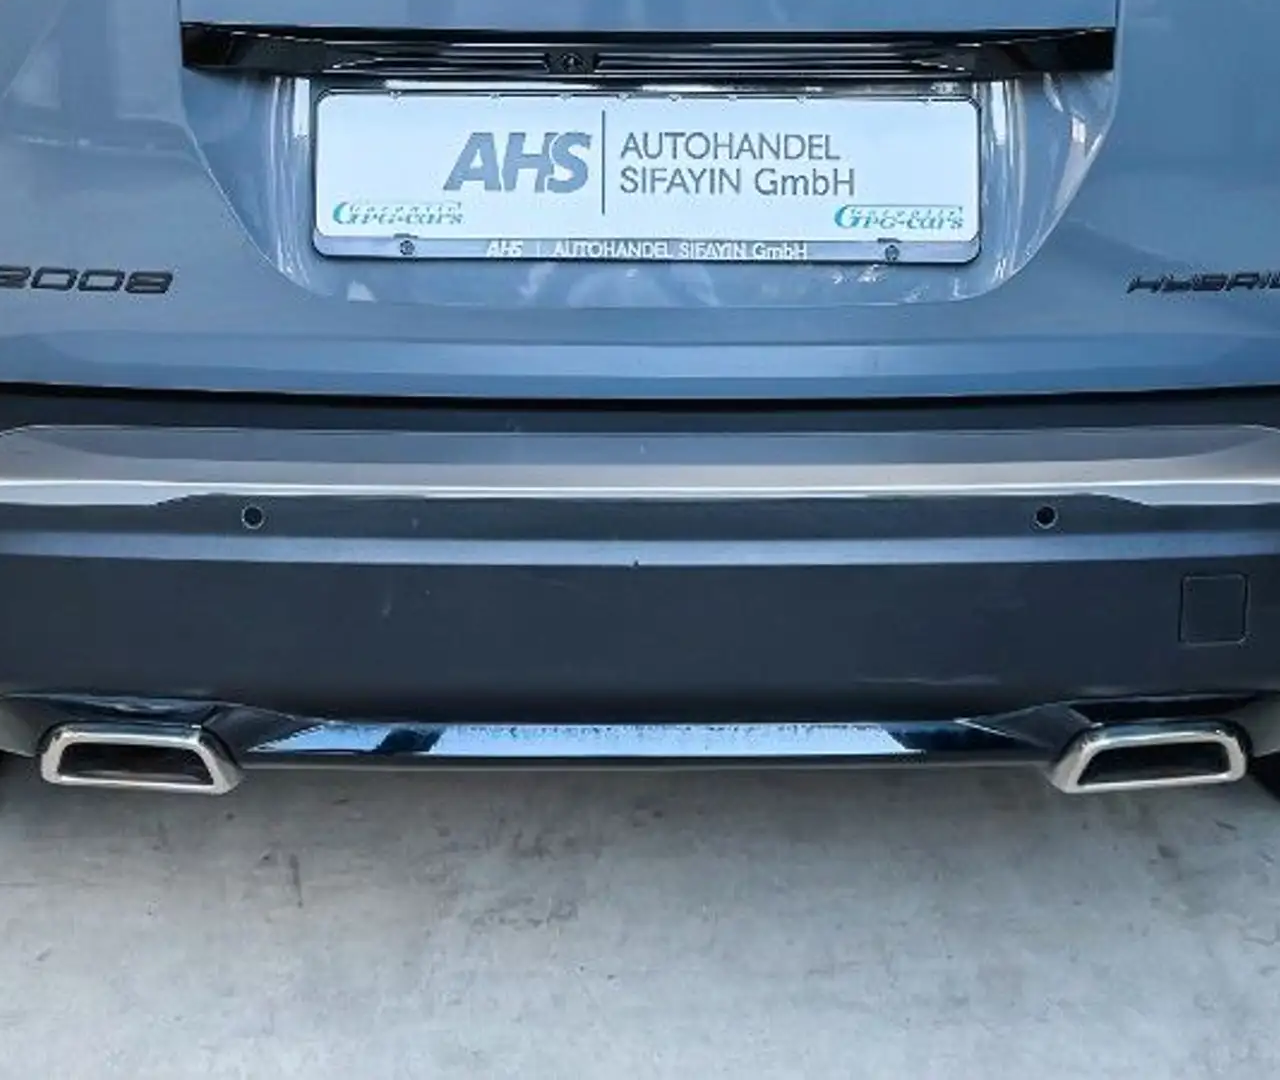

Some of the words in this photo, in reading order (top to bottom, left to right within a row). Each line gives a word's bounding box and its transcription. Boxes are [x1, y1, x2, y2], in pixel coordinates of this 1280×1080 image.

[620, 131, 841, 161] AUTOHANDEL
[443, 131, 593, 194] AHS
[620, 166, 742, 196] SIFAYIN
[754, 168, 856, 197] GmbH
[486, 240, 524, 259] AHS
[552, 240, 672, 260] AUTOHANDEL
[678, 241, 747, 260] SIFAYIN
[752, 241, 808, 261] GmbH
